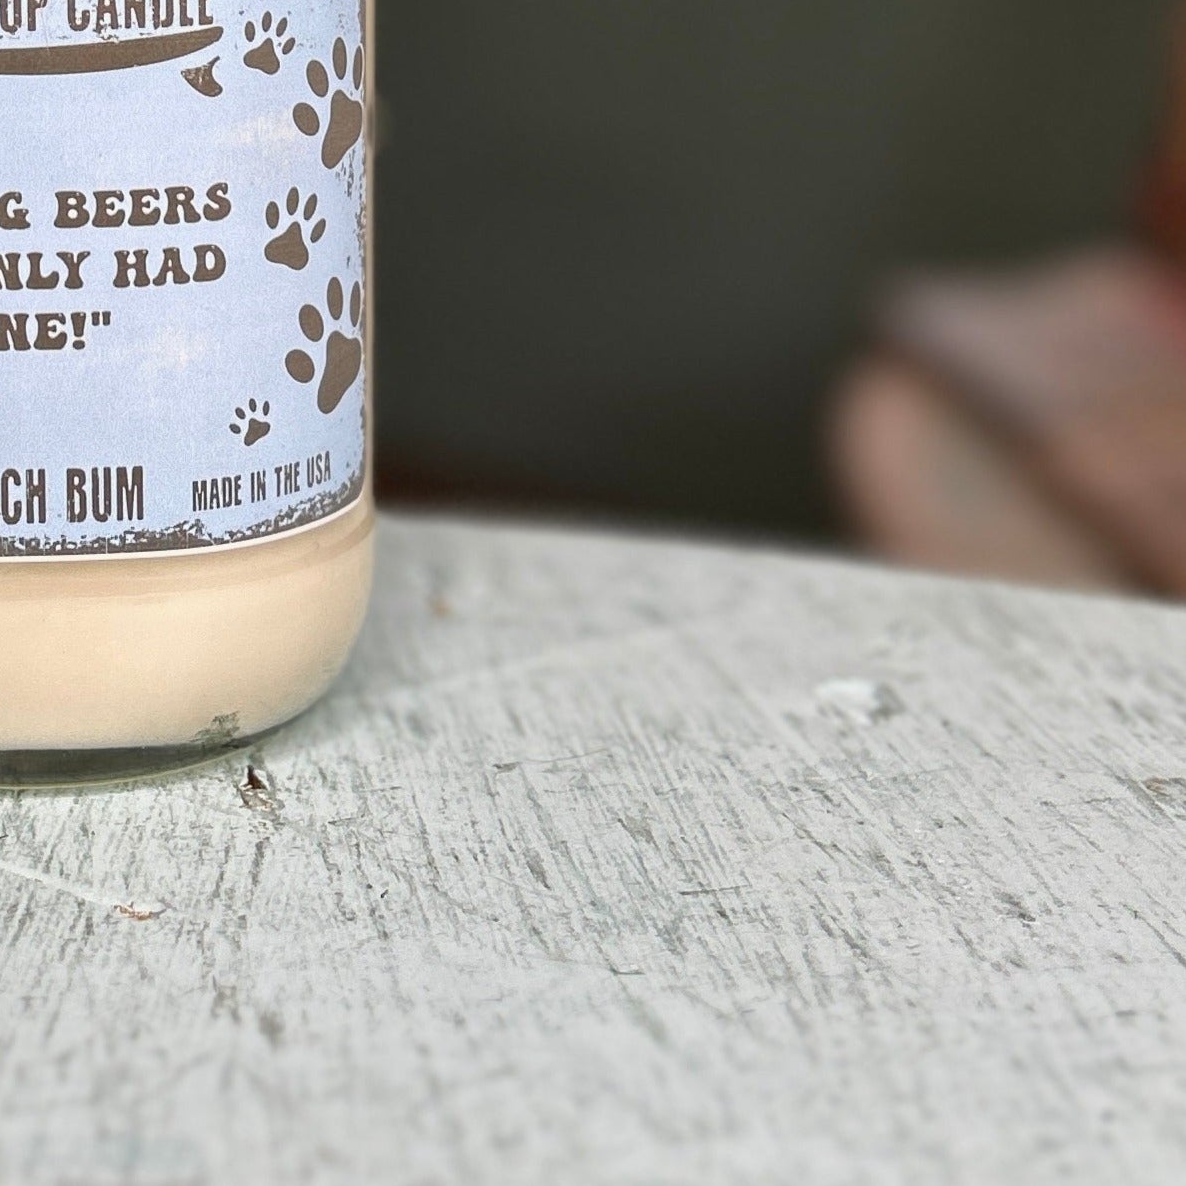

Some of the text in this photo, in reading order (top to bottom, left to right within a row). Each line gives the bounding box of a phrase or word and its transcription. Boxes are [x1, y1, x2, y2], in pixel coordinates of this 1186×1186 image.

[53, 182, 232, 229] BEERS
[112, 244, 227, 288] HAD
[66, 465, 144, 523] BUM
[192, 451, 331, 512] MADE IN THE USA
